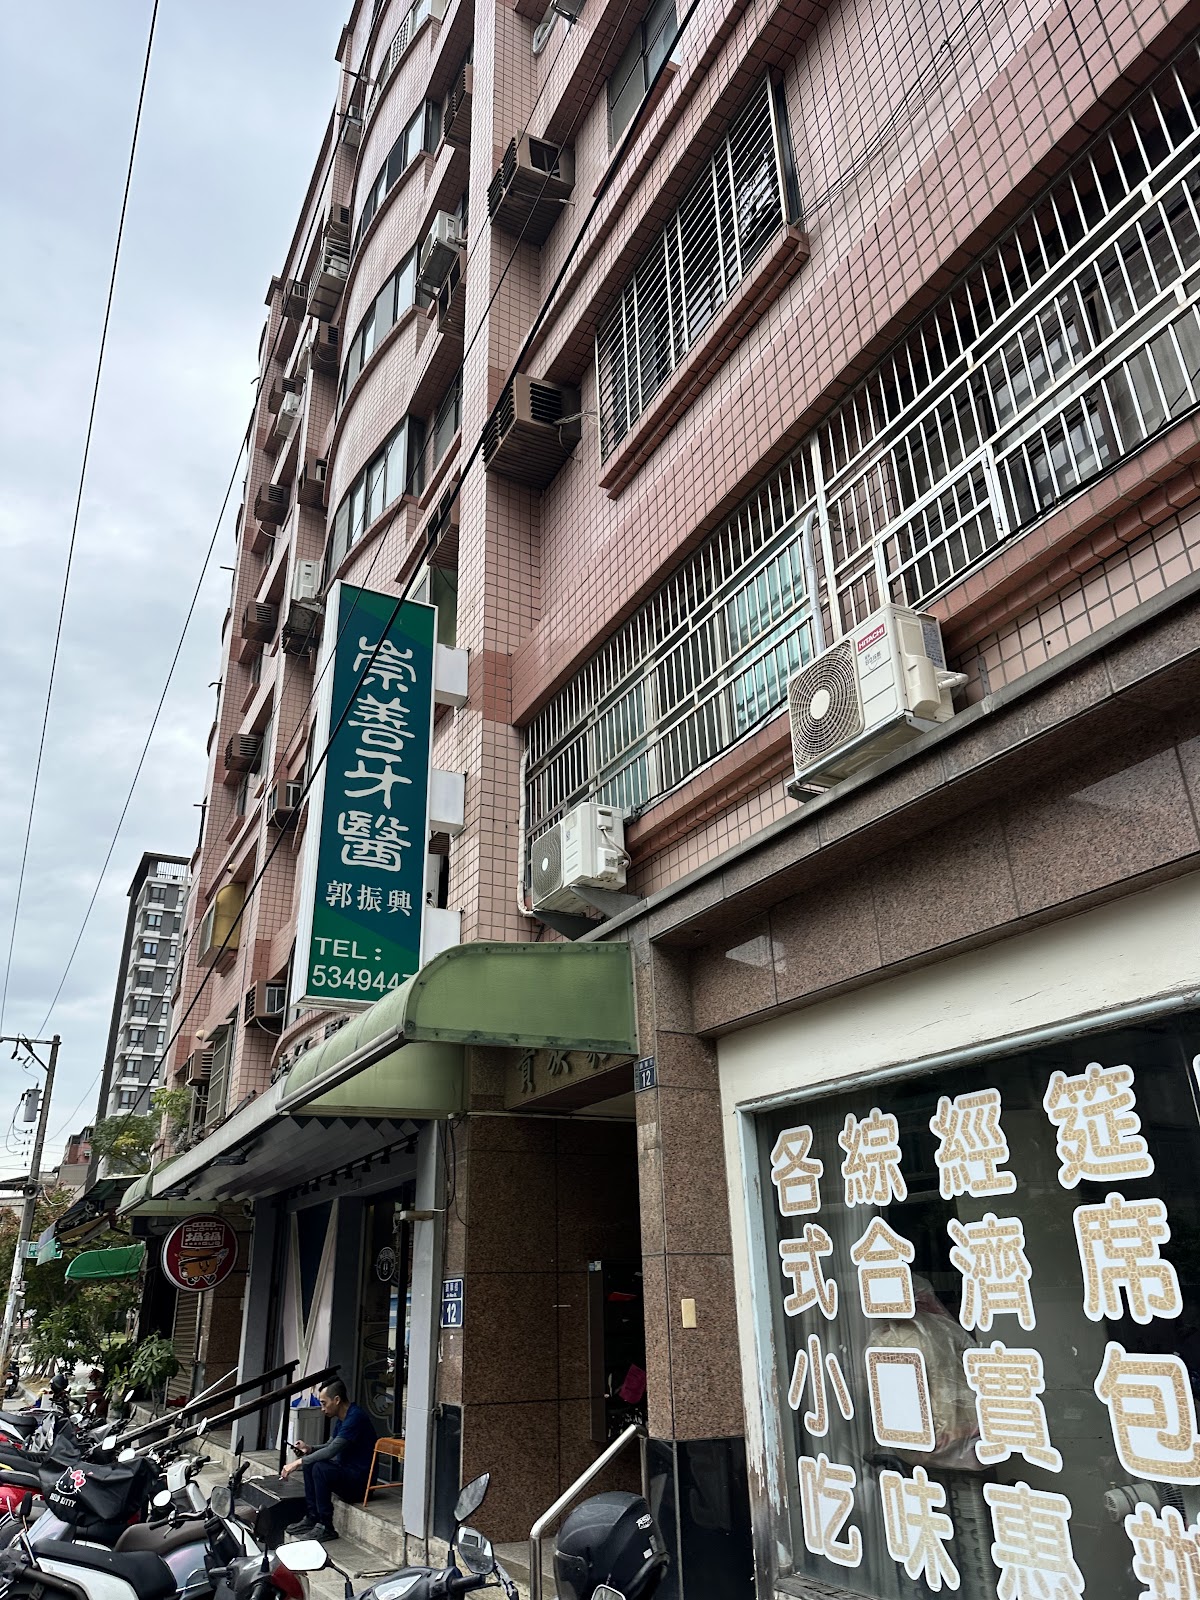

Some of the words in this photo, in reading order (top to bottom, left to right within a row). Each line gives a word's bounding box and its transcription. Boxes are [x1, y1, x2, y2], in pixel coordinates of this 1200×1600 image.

[858, 626, 884, 650] HITACHI
[337, 635, 417, 871] 崇善牙醫
[325, 879, 413, 917] 郭振興
[641, 1070, 651, 1087] 12
[446, 1302, 457, 1323] 12
[770, 1124, 862, 1568] 各式小吃
[838, 1107, 961, 1592] 綜合口味
[929, 1087, 1086, 1600] 經濟實惠
